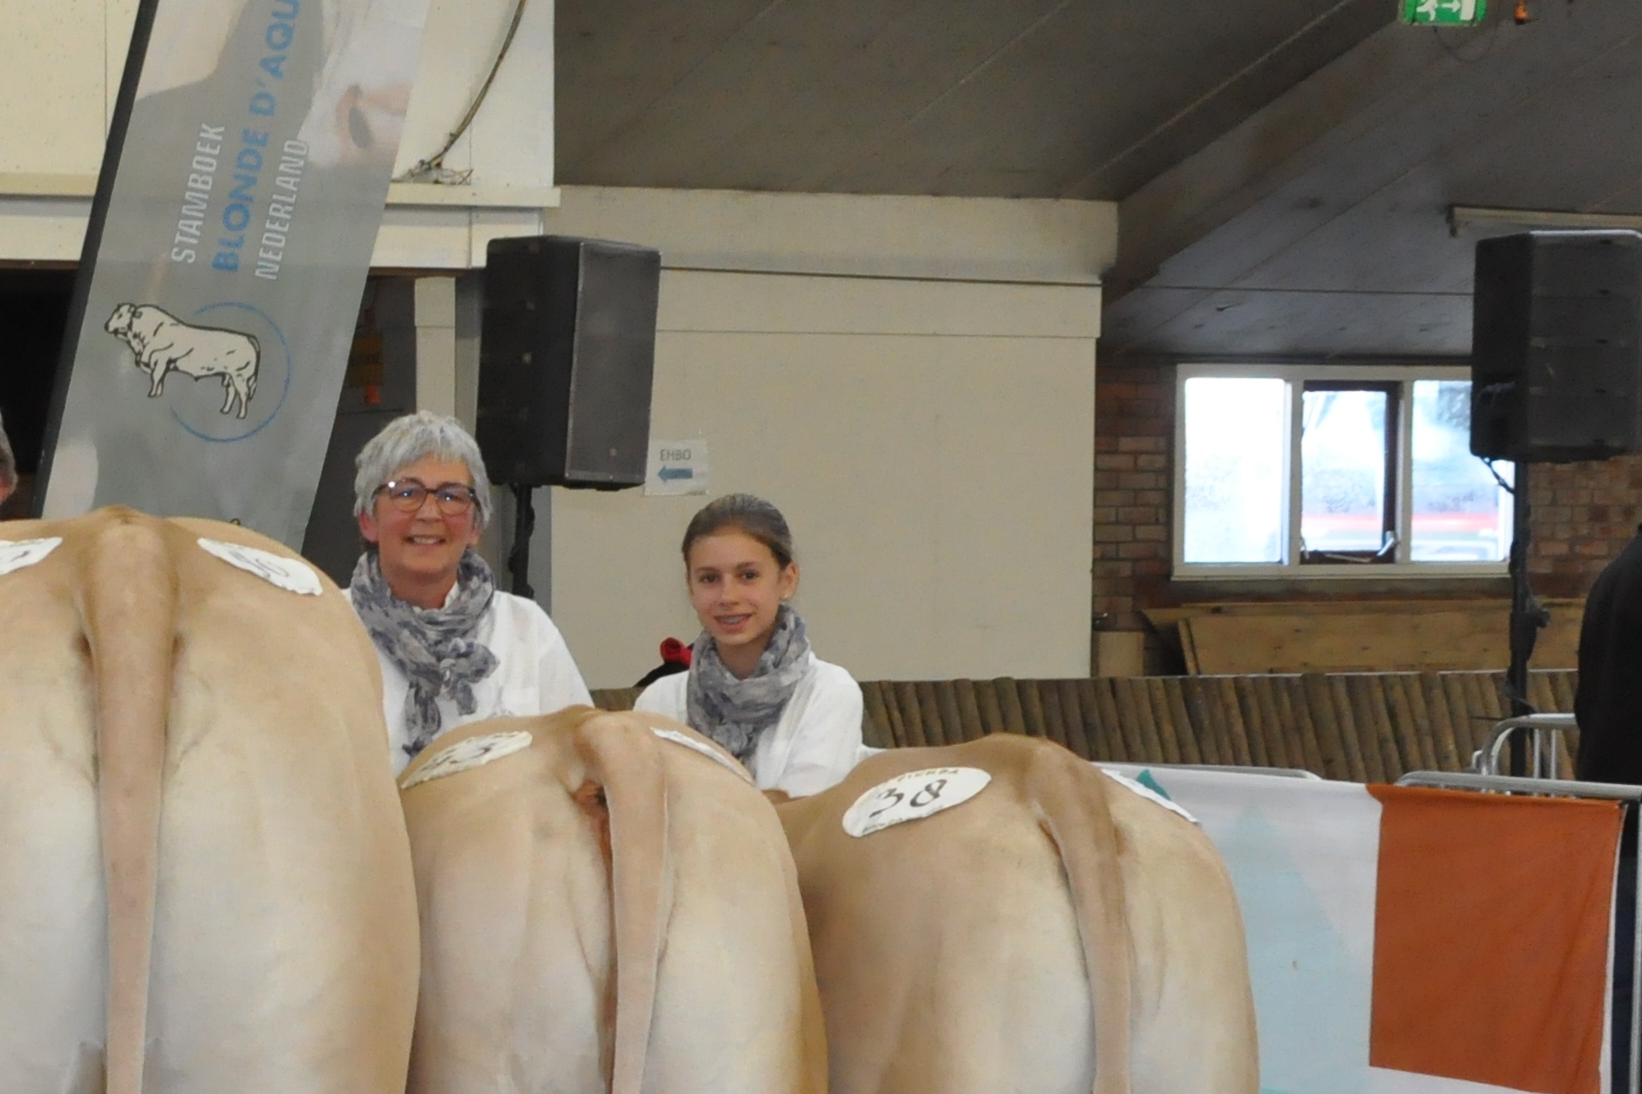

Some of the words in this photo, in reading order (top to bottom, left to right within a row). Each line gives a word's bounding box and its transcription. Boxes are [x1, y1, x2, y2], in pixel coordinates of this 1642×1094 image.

[171, 122, 225, 263] STAMBOEK
[212, 127, 269, 273] BLONDE
[255, 138, 307, 280] NEDERLAND
[659, 448, 692, 461] EHBO
[868, 779, 947, 818] 38
